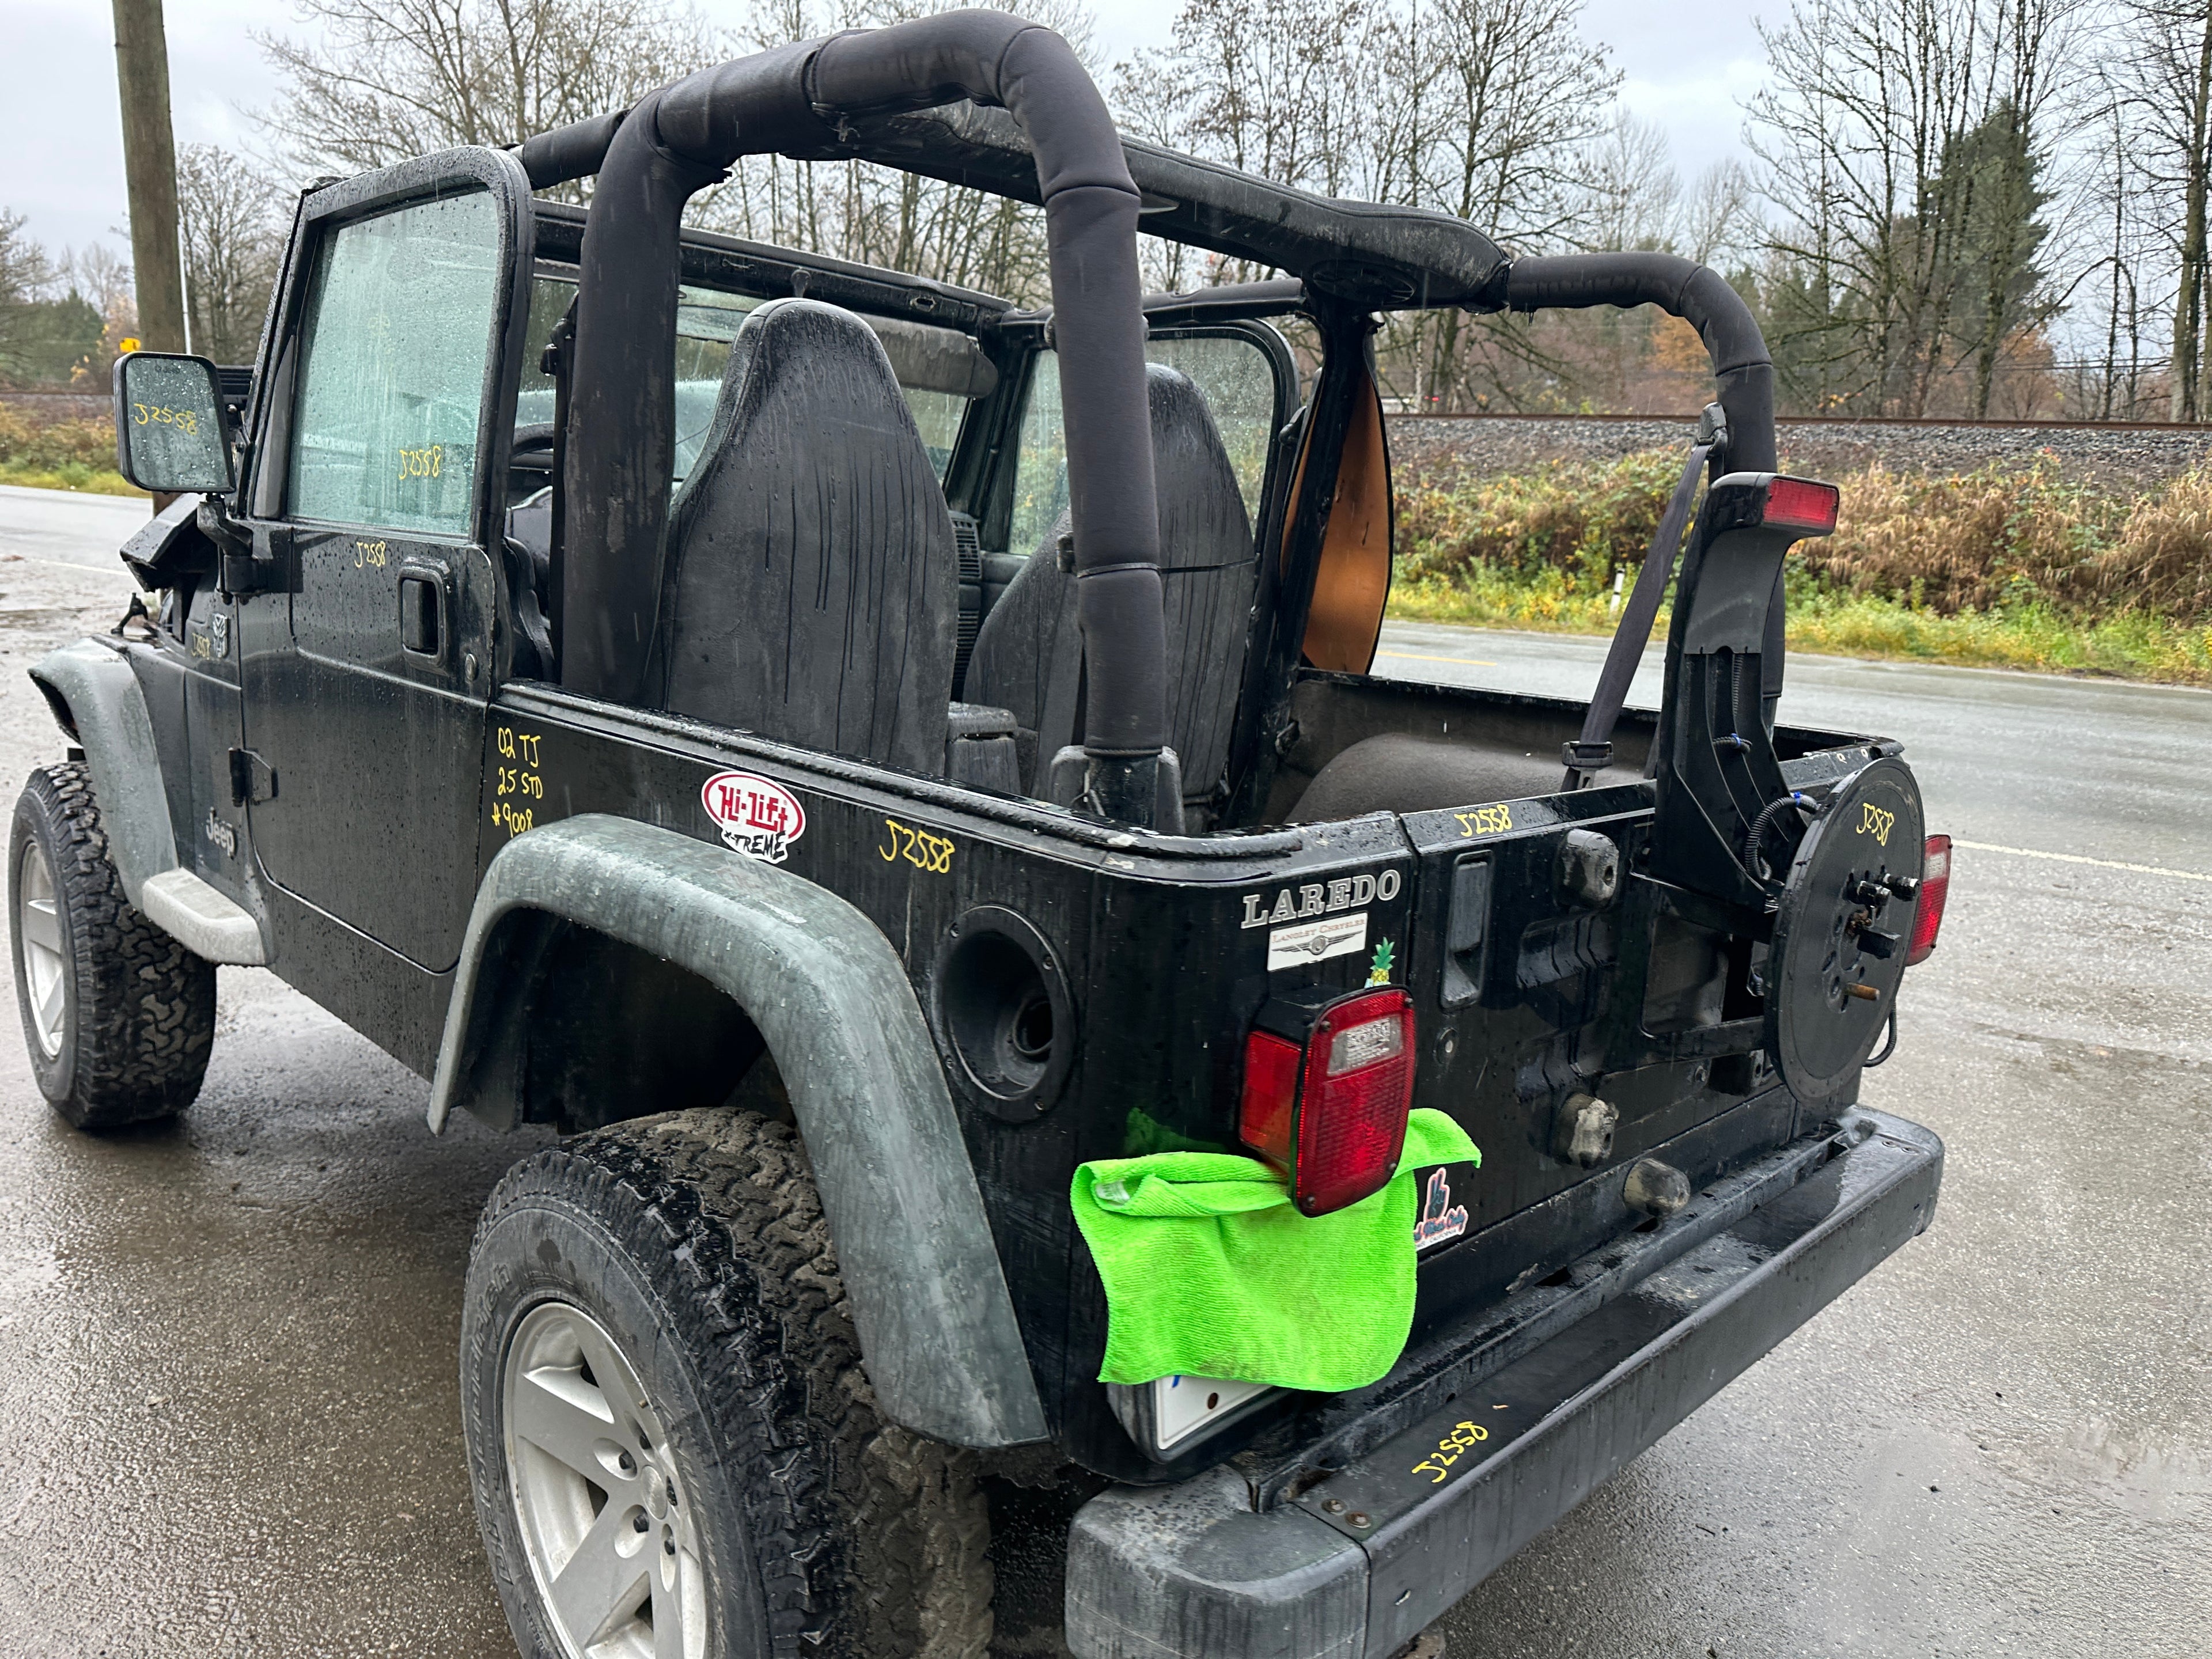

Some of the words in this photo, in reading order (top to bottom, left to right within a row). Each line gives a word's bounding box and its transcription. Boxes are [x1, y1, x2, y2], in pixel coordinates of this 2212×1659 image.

[134, 403, 197, 435] J2558
[398, 445, 442, 480] J2558
[354, 540, 386, 568] J2558
[498, 727, 516, 759] 02
[519, 734, 541, 768] TJ
[521, 772, 543, 800] STD
[206, 806, 235, 857] Jeep
[1453, 804, 1513, 837] J2558
[1856, 802, 1895, 847] J2558
[878, 819, 956, 874] J2558
[1240, 869, 1402, 929] LAREDO
[1411, 1421, 1488, 1483] J2558
